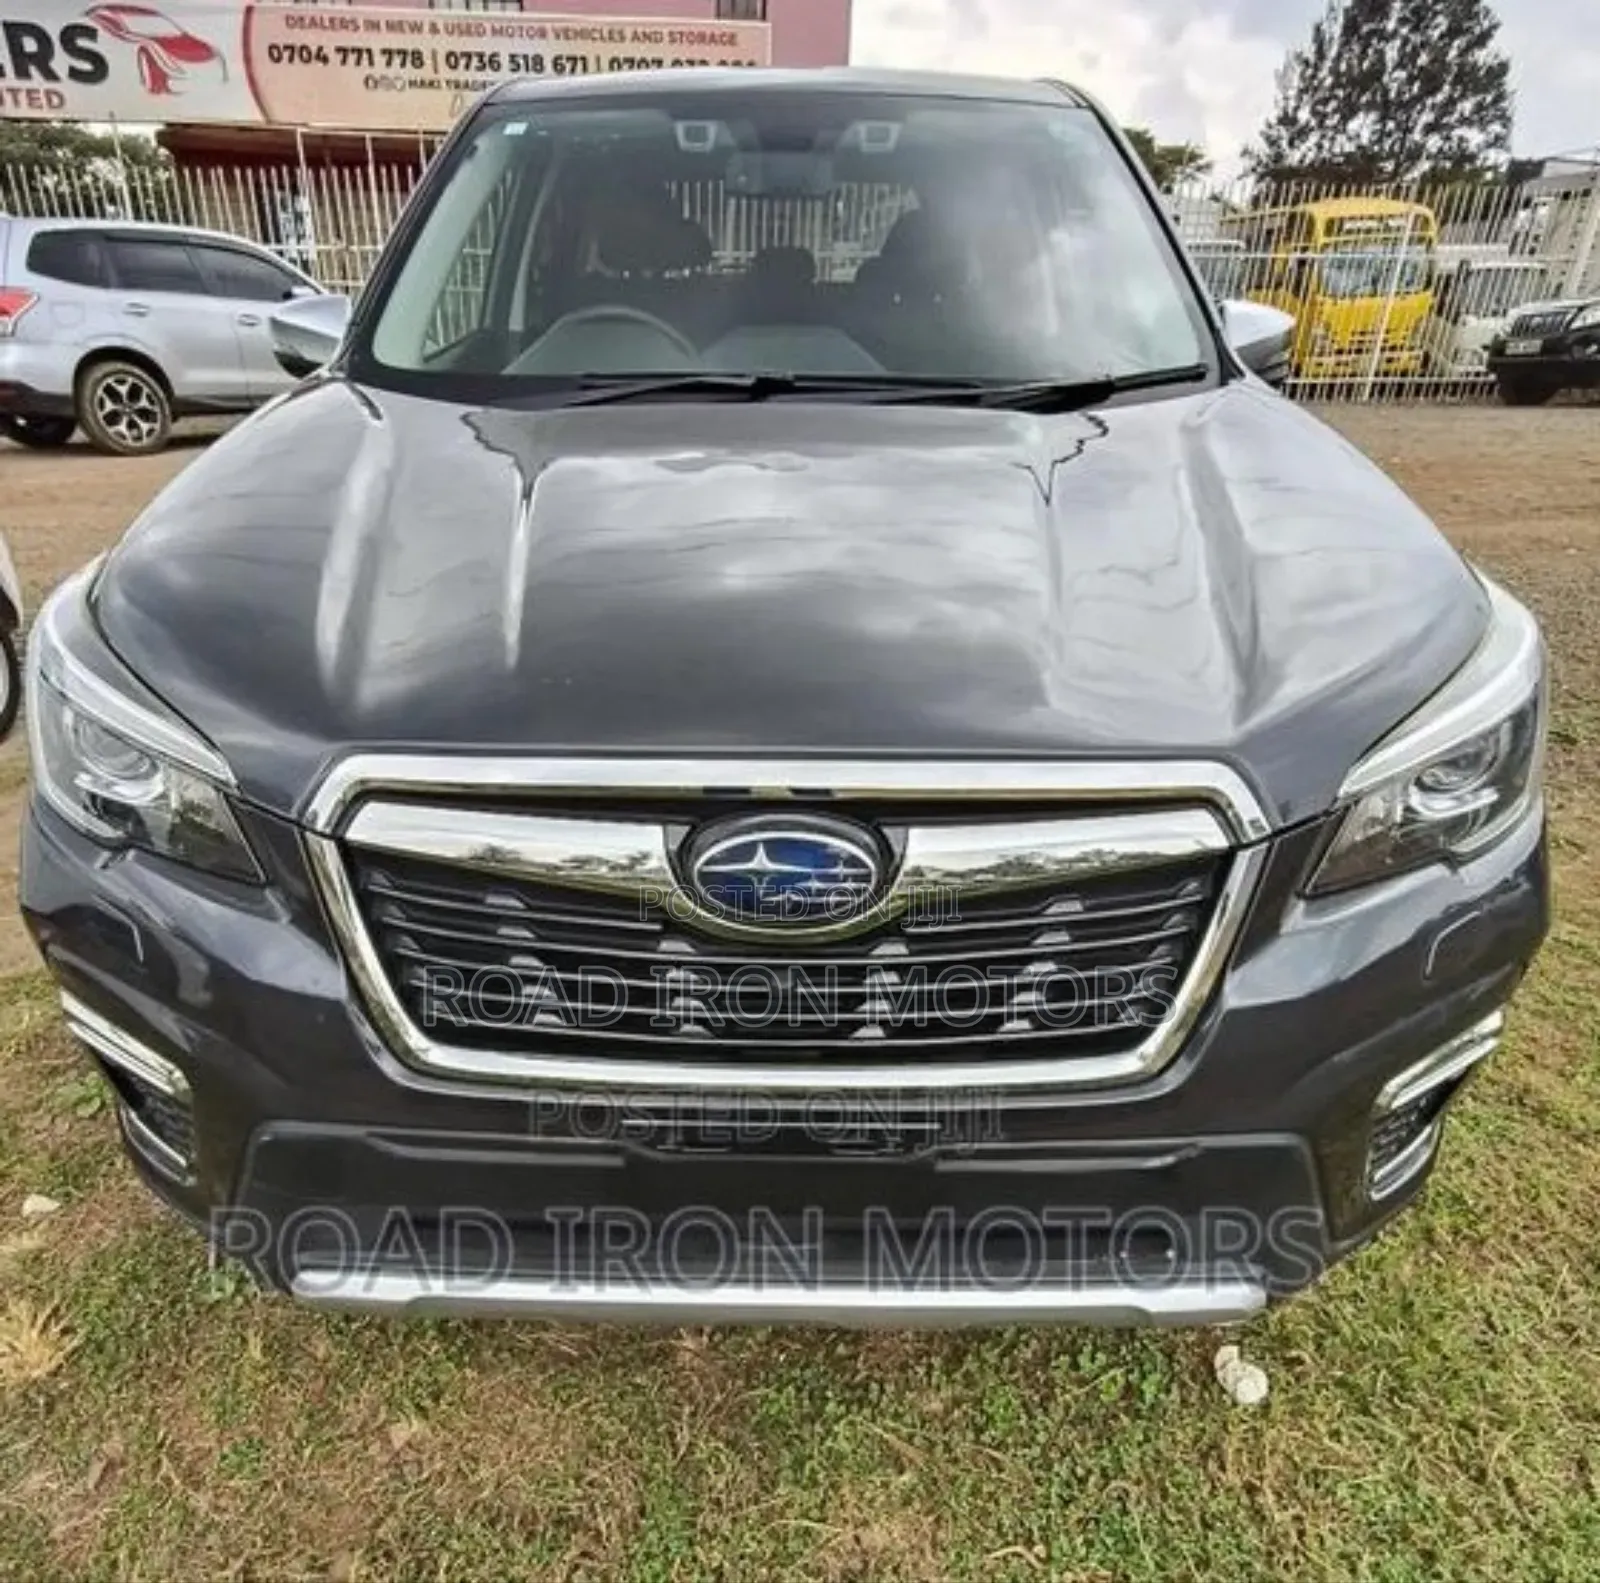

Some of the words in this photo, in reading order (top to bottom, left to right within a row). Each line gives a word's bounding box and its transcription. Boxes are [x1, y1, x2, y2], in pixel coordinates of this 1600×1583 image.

[286, 14, 360, 32] DEALERS
[364, 19, 381, 32] IN
[385, 20, 424, 34] NEW
[443, 22, 486, 37] USED
[491, 23, 547, 39] MOTOR
[551, 26, 626, 42] VEHICLES
[631, 28, 663, 43] AND
[668, 29, 738, 46] STORAGE
[0, 21, 109, 84] RS
[268, 43, 329, 66] 0704
[334, 45, 374, 67] 771
[380, 47, 424, 69] 778
[445, 51, 501, 72] 0736
[508, 53, 544, 73] 518
[552, 54, 588, 74] 671
